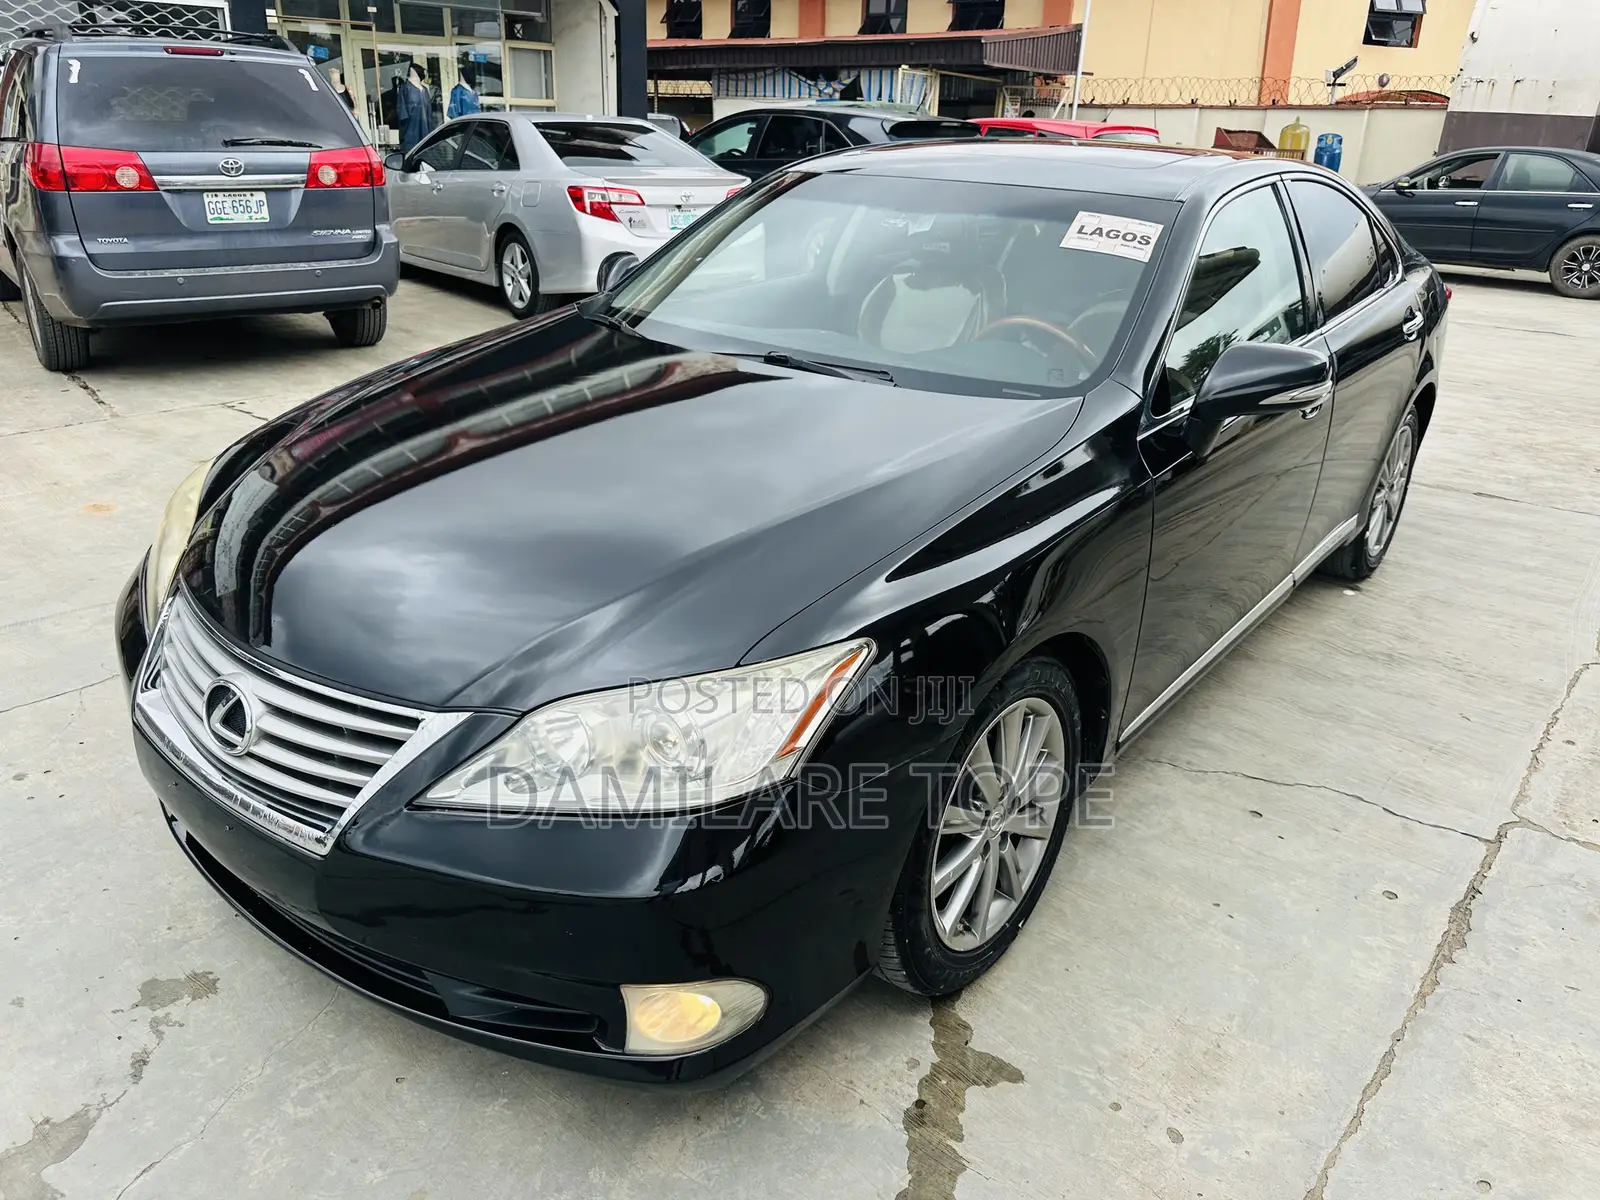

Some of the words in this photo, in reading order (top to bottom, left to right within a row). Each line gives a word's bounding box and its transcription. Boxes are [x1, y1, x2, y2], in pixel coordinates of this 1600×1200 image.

[311, 228, 352, 237] SIENNA
[1076, 224, 1152, 246] LAGOS
[96, 237, 129, 245] TOYOTA
